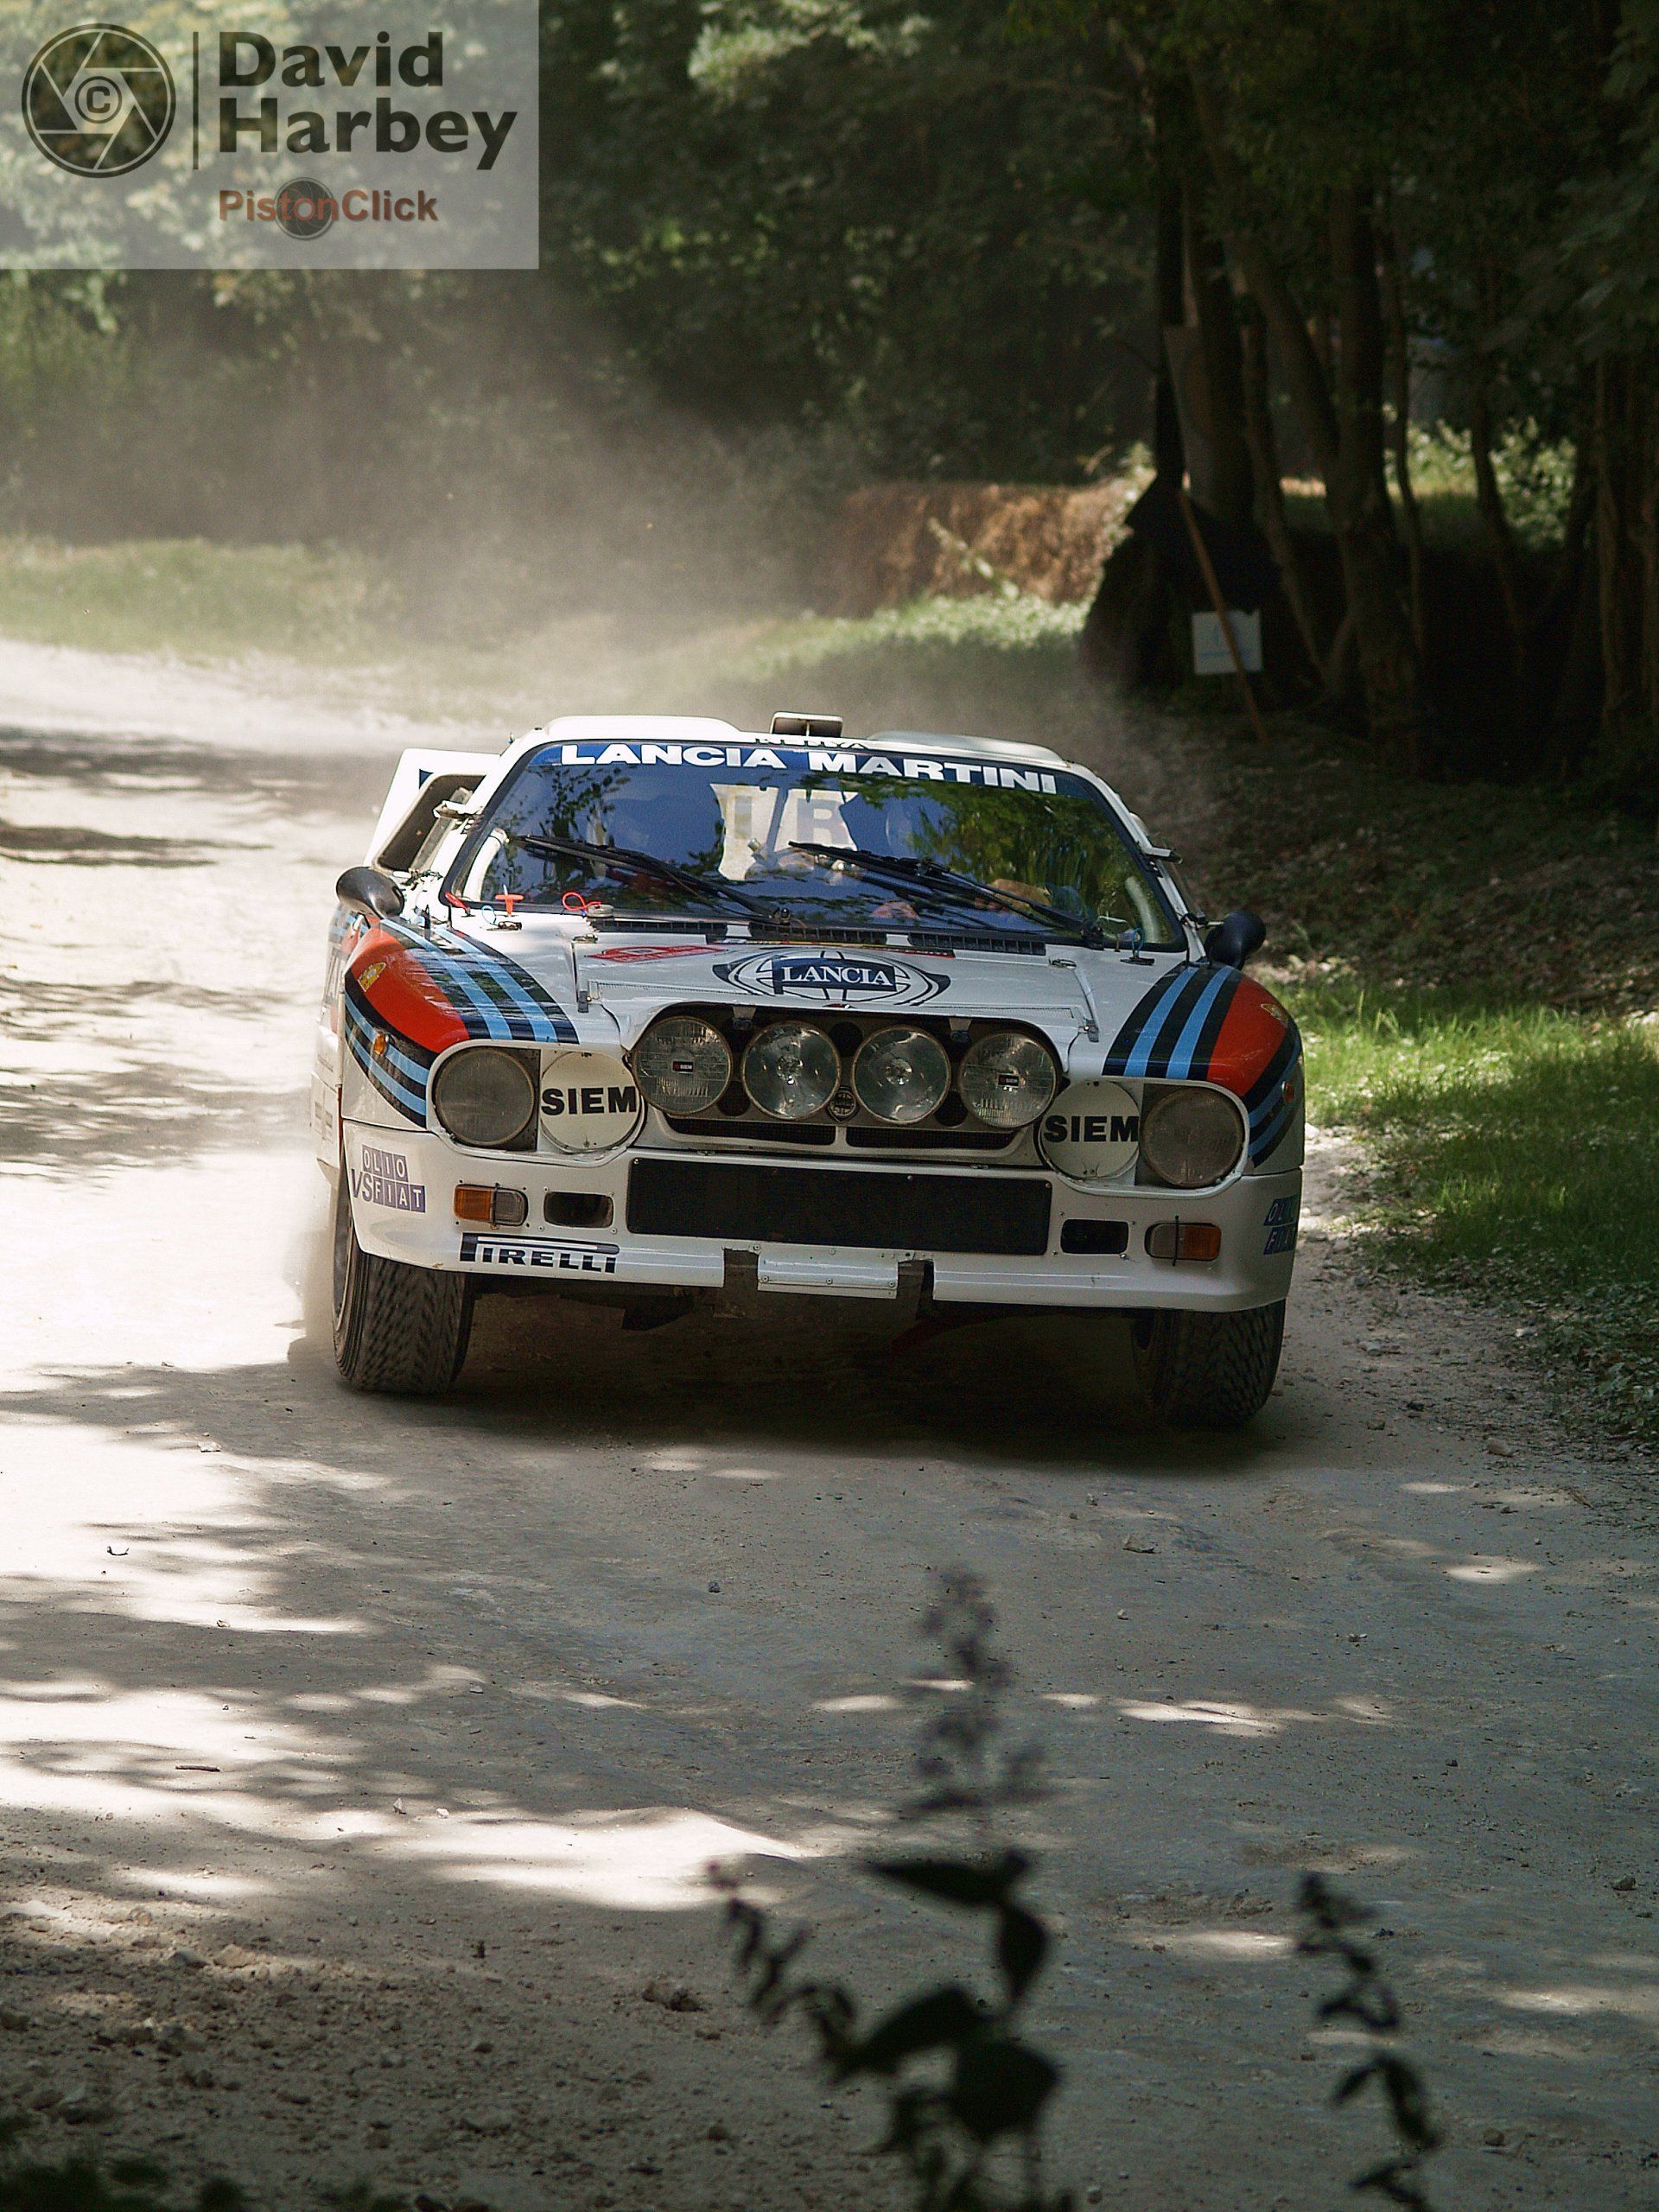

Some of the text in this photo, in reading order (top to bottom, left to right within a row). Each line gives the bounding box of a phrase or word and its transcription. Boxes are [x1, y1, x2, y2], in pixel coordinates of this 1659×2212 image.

[562, 743, 1057, 794] LANCIA MARTINI
[781, 966, 893, 987] LANCIA
[541, 1085, 637, 1116] SIEM
[1043, 1115, 1140, 1142] SIEM
[364, 1149, 405, 1178] OLIO
[375, 1180, 422, 1208] FIAT
[460, 1232, 620, 1273] PIRELLI
